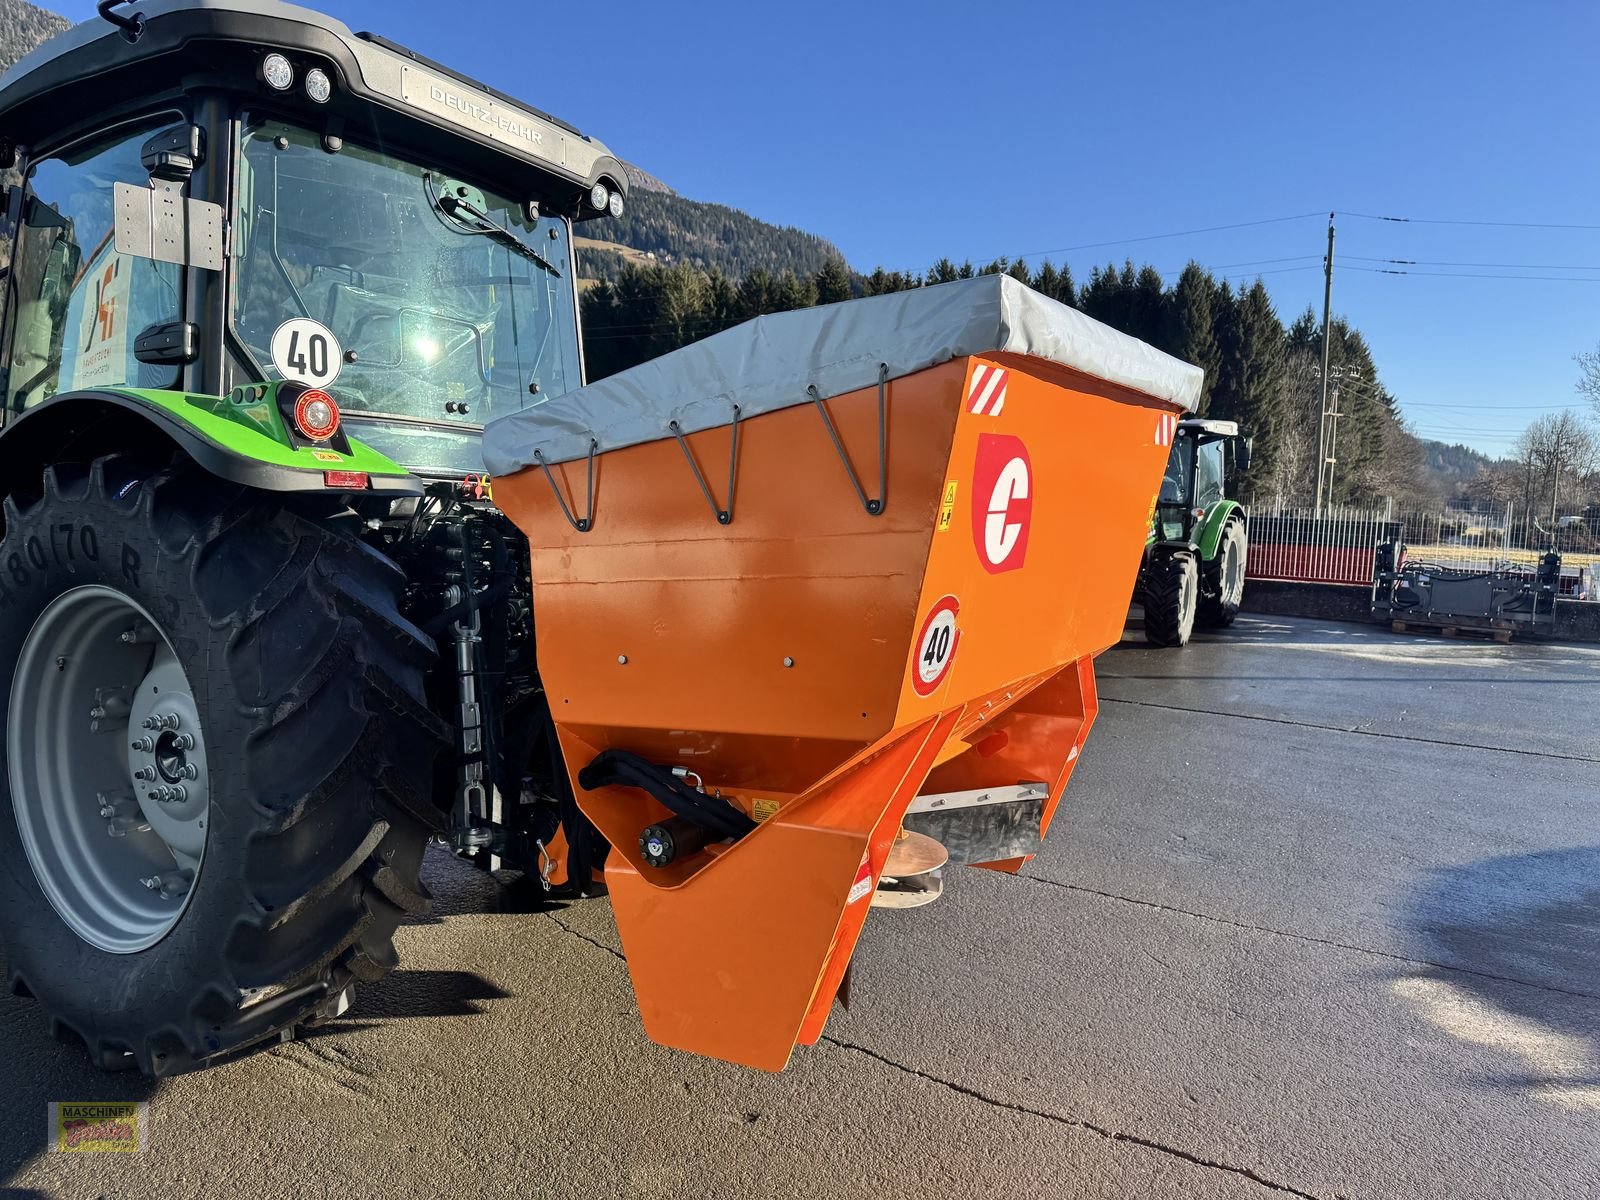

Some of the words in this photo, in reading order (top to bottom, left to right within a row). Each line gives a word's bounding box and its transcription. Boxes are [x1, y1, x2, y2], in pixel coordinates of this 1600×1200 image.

[430, 86, 543, 145] DEUTZ-FAHR
[287, 330, 329, 378] 40
[923, 625, 950, 666] 40
